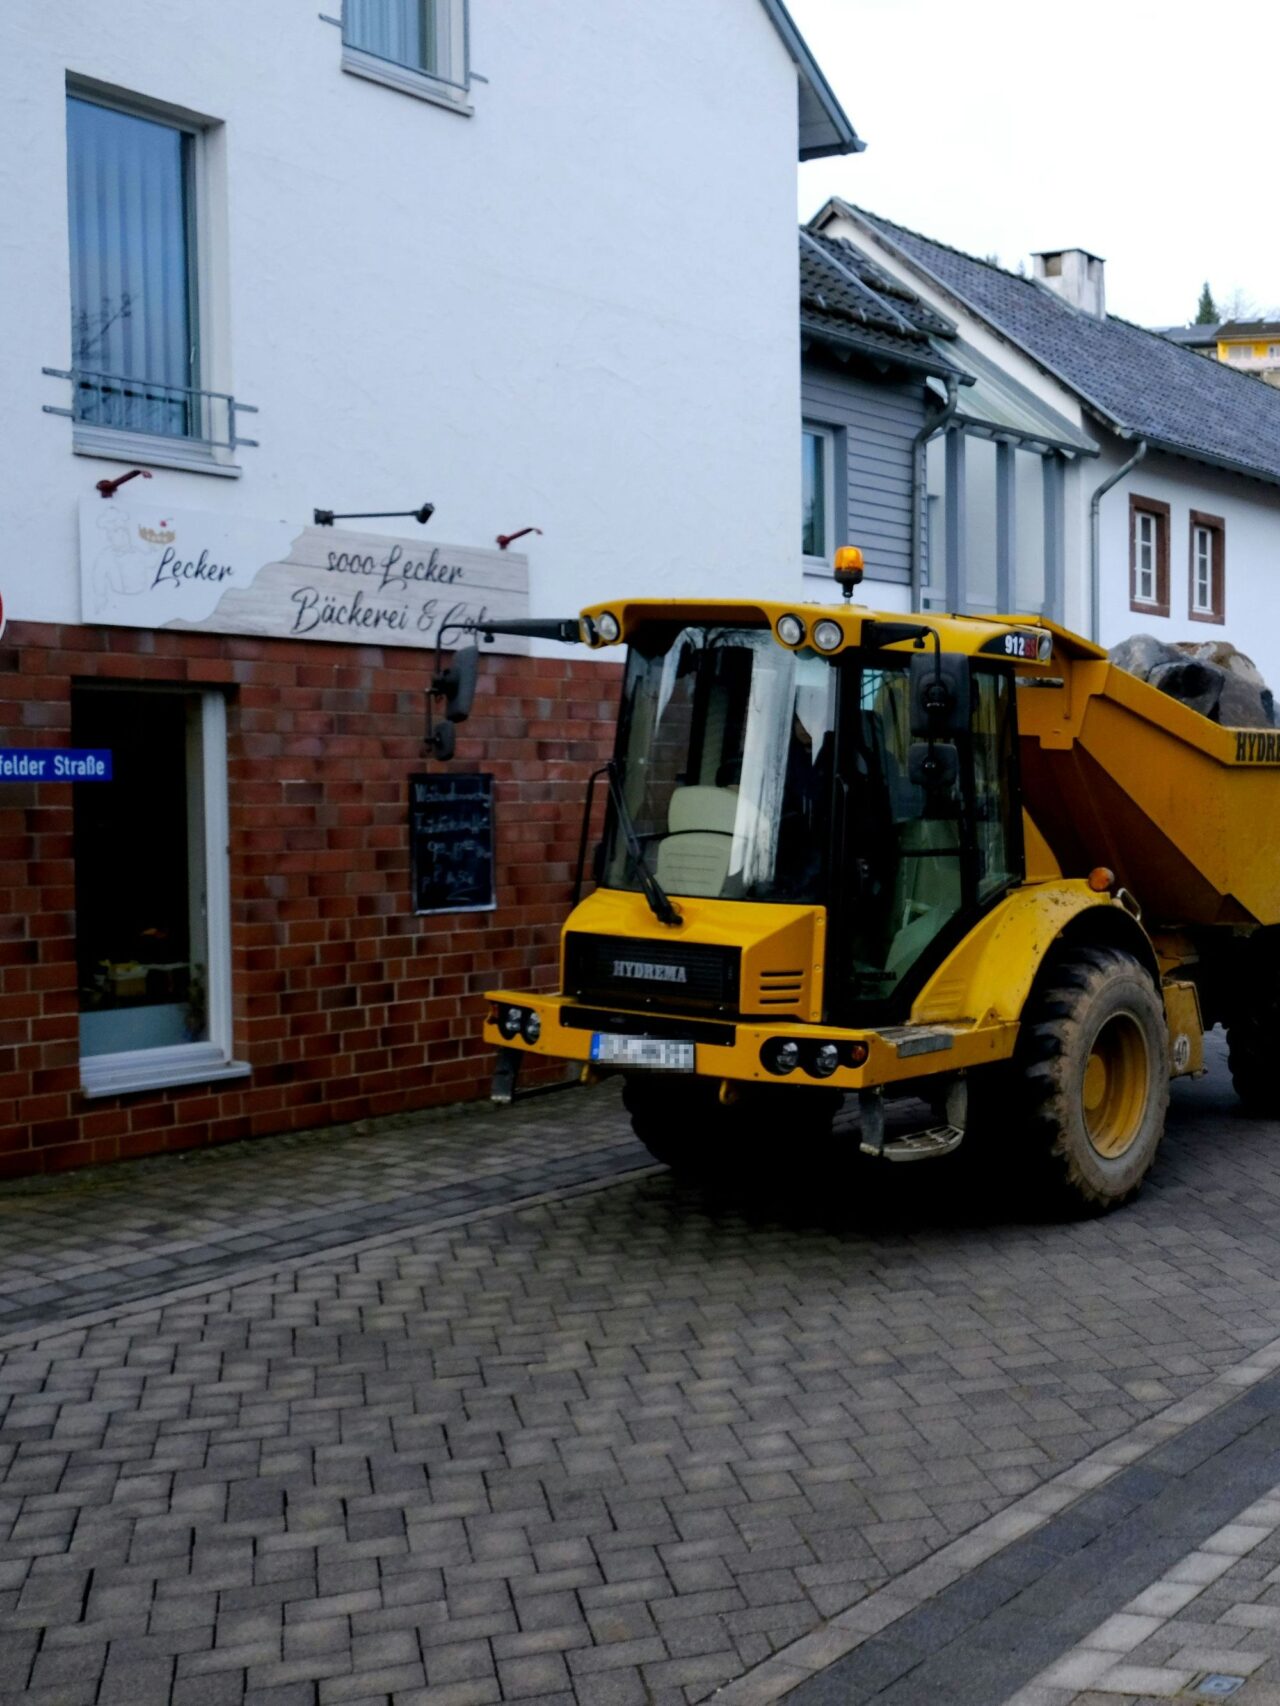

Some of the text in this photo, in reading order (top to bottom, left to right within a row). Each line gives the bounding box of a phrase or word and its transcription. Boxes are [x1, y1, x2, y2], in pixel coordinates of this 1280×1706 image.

[150, 546, 234, 590] Lecker
[327, 544, 464, 592] sooo Lecker
[291, 586, 497, 648] Bäckerei & Caf
[54, 754, 105, 776] Straße
[612, 960, 688, 983] HYDREMA
